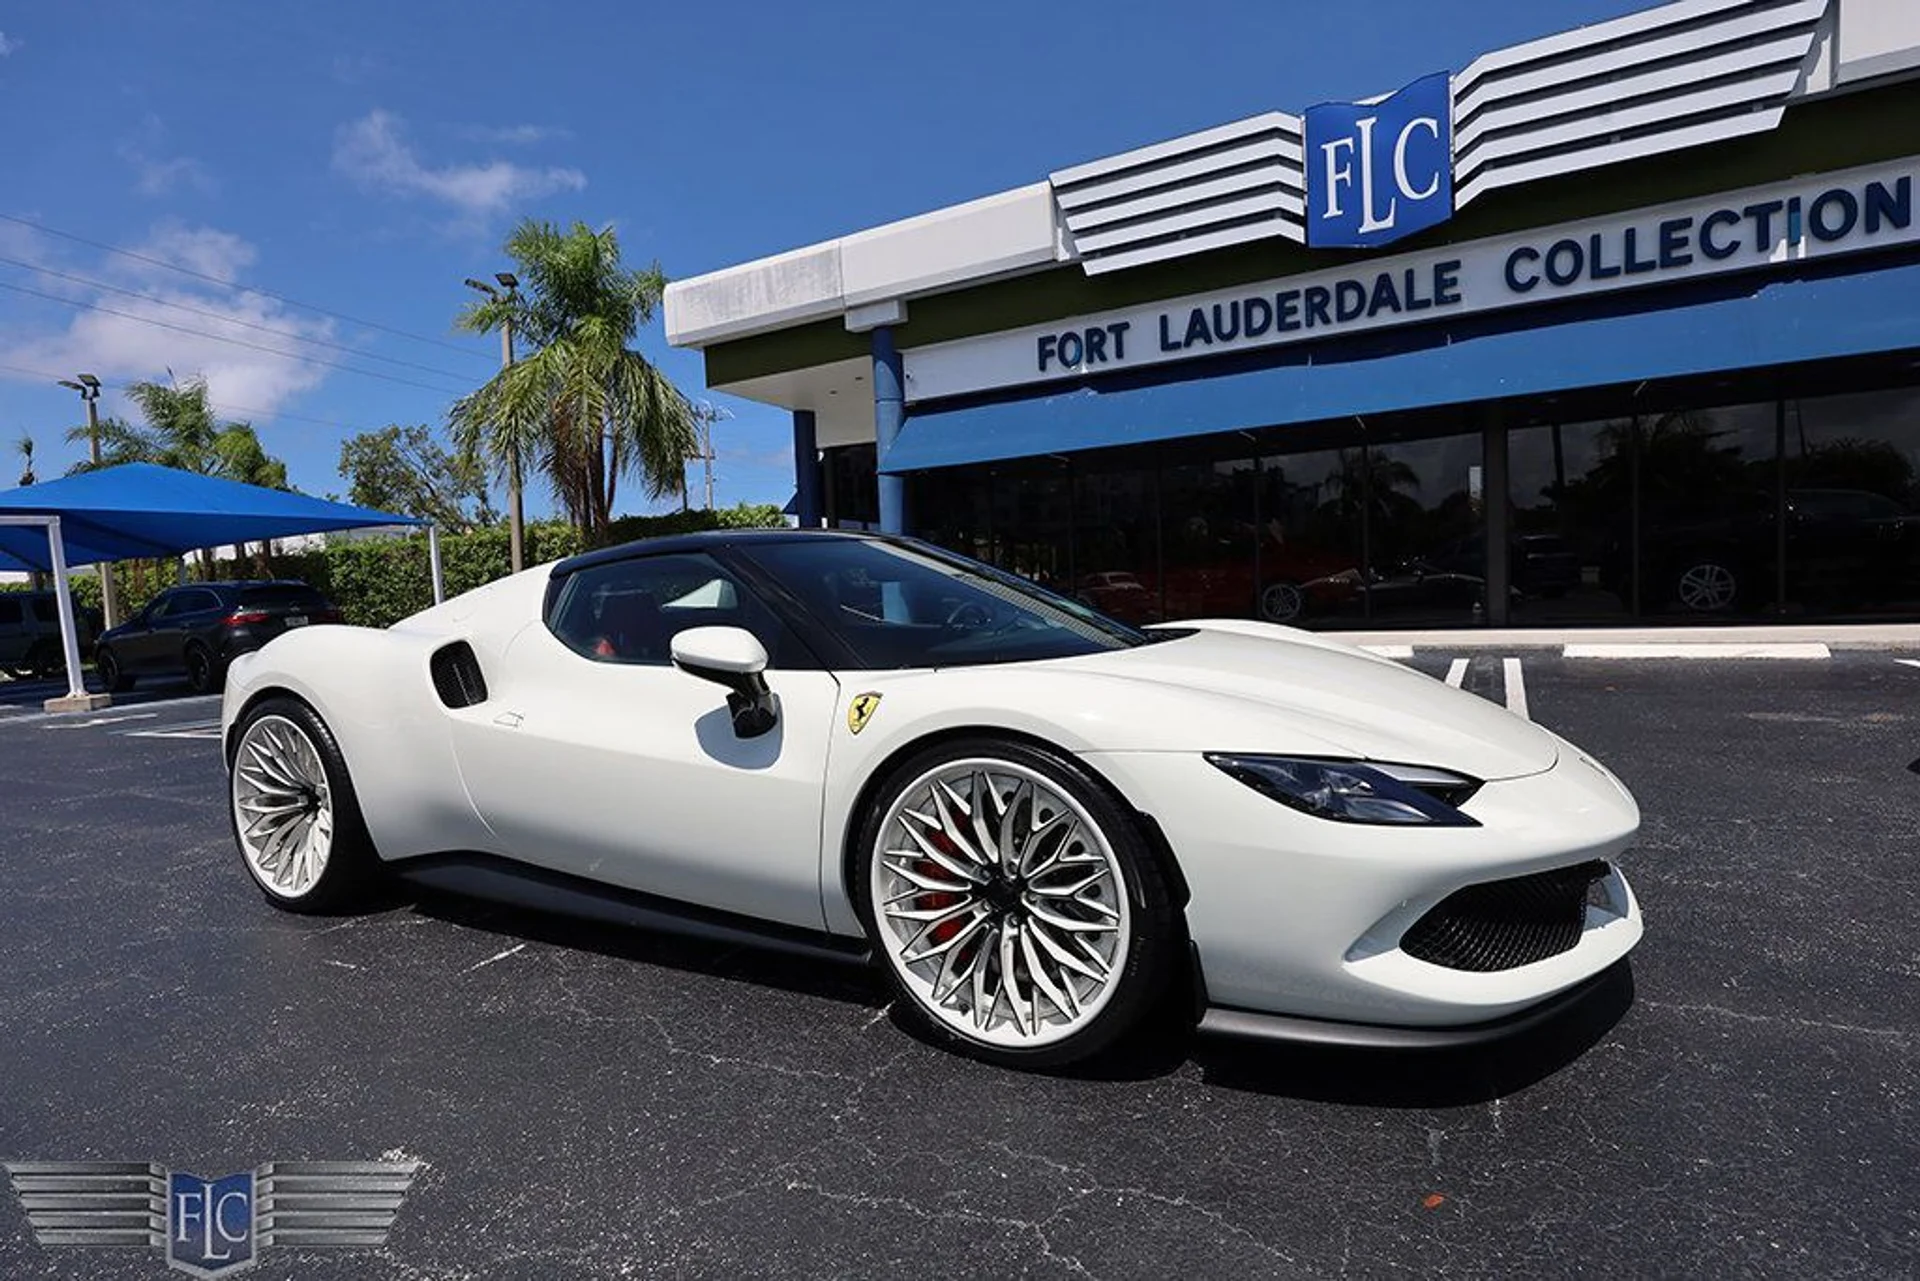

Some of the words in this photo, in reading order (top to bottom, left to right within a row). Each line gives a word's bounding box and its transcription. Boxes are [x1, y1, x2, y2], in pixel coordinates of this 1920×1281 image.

[1321, 116, 1440, 234] FLC
[1037, 323, 1130, 371] FORT
[1159, 260, 1462, 352] LAUDERDALE
[1504, 176, 1911, 293] COLLECTION
